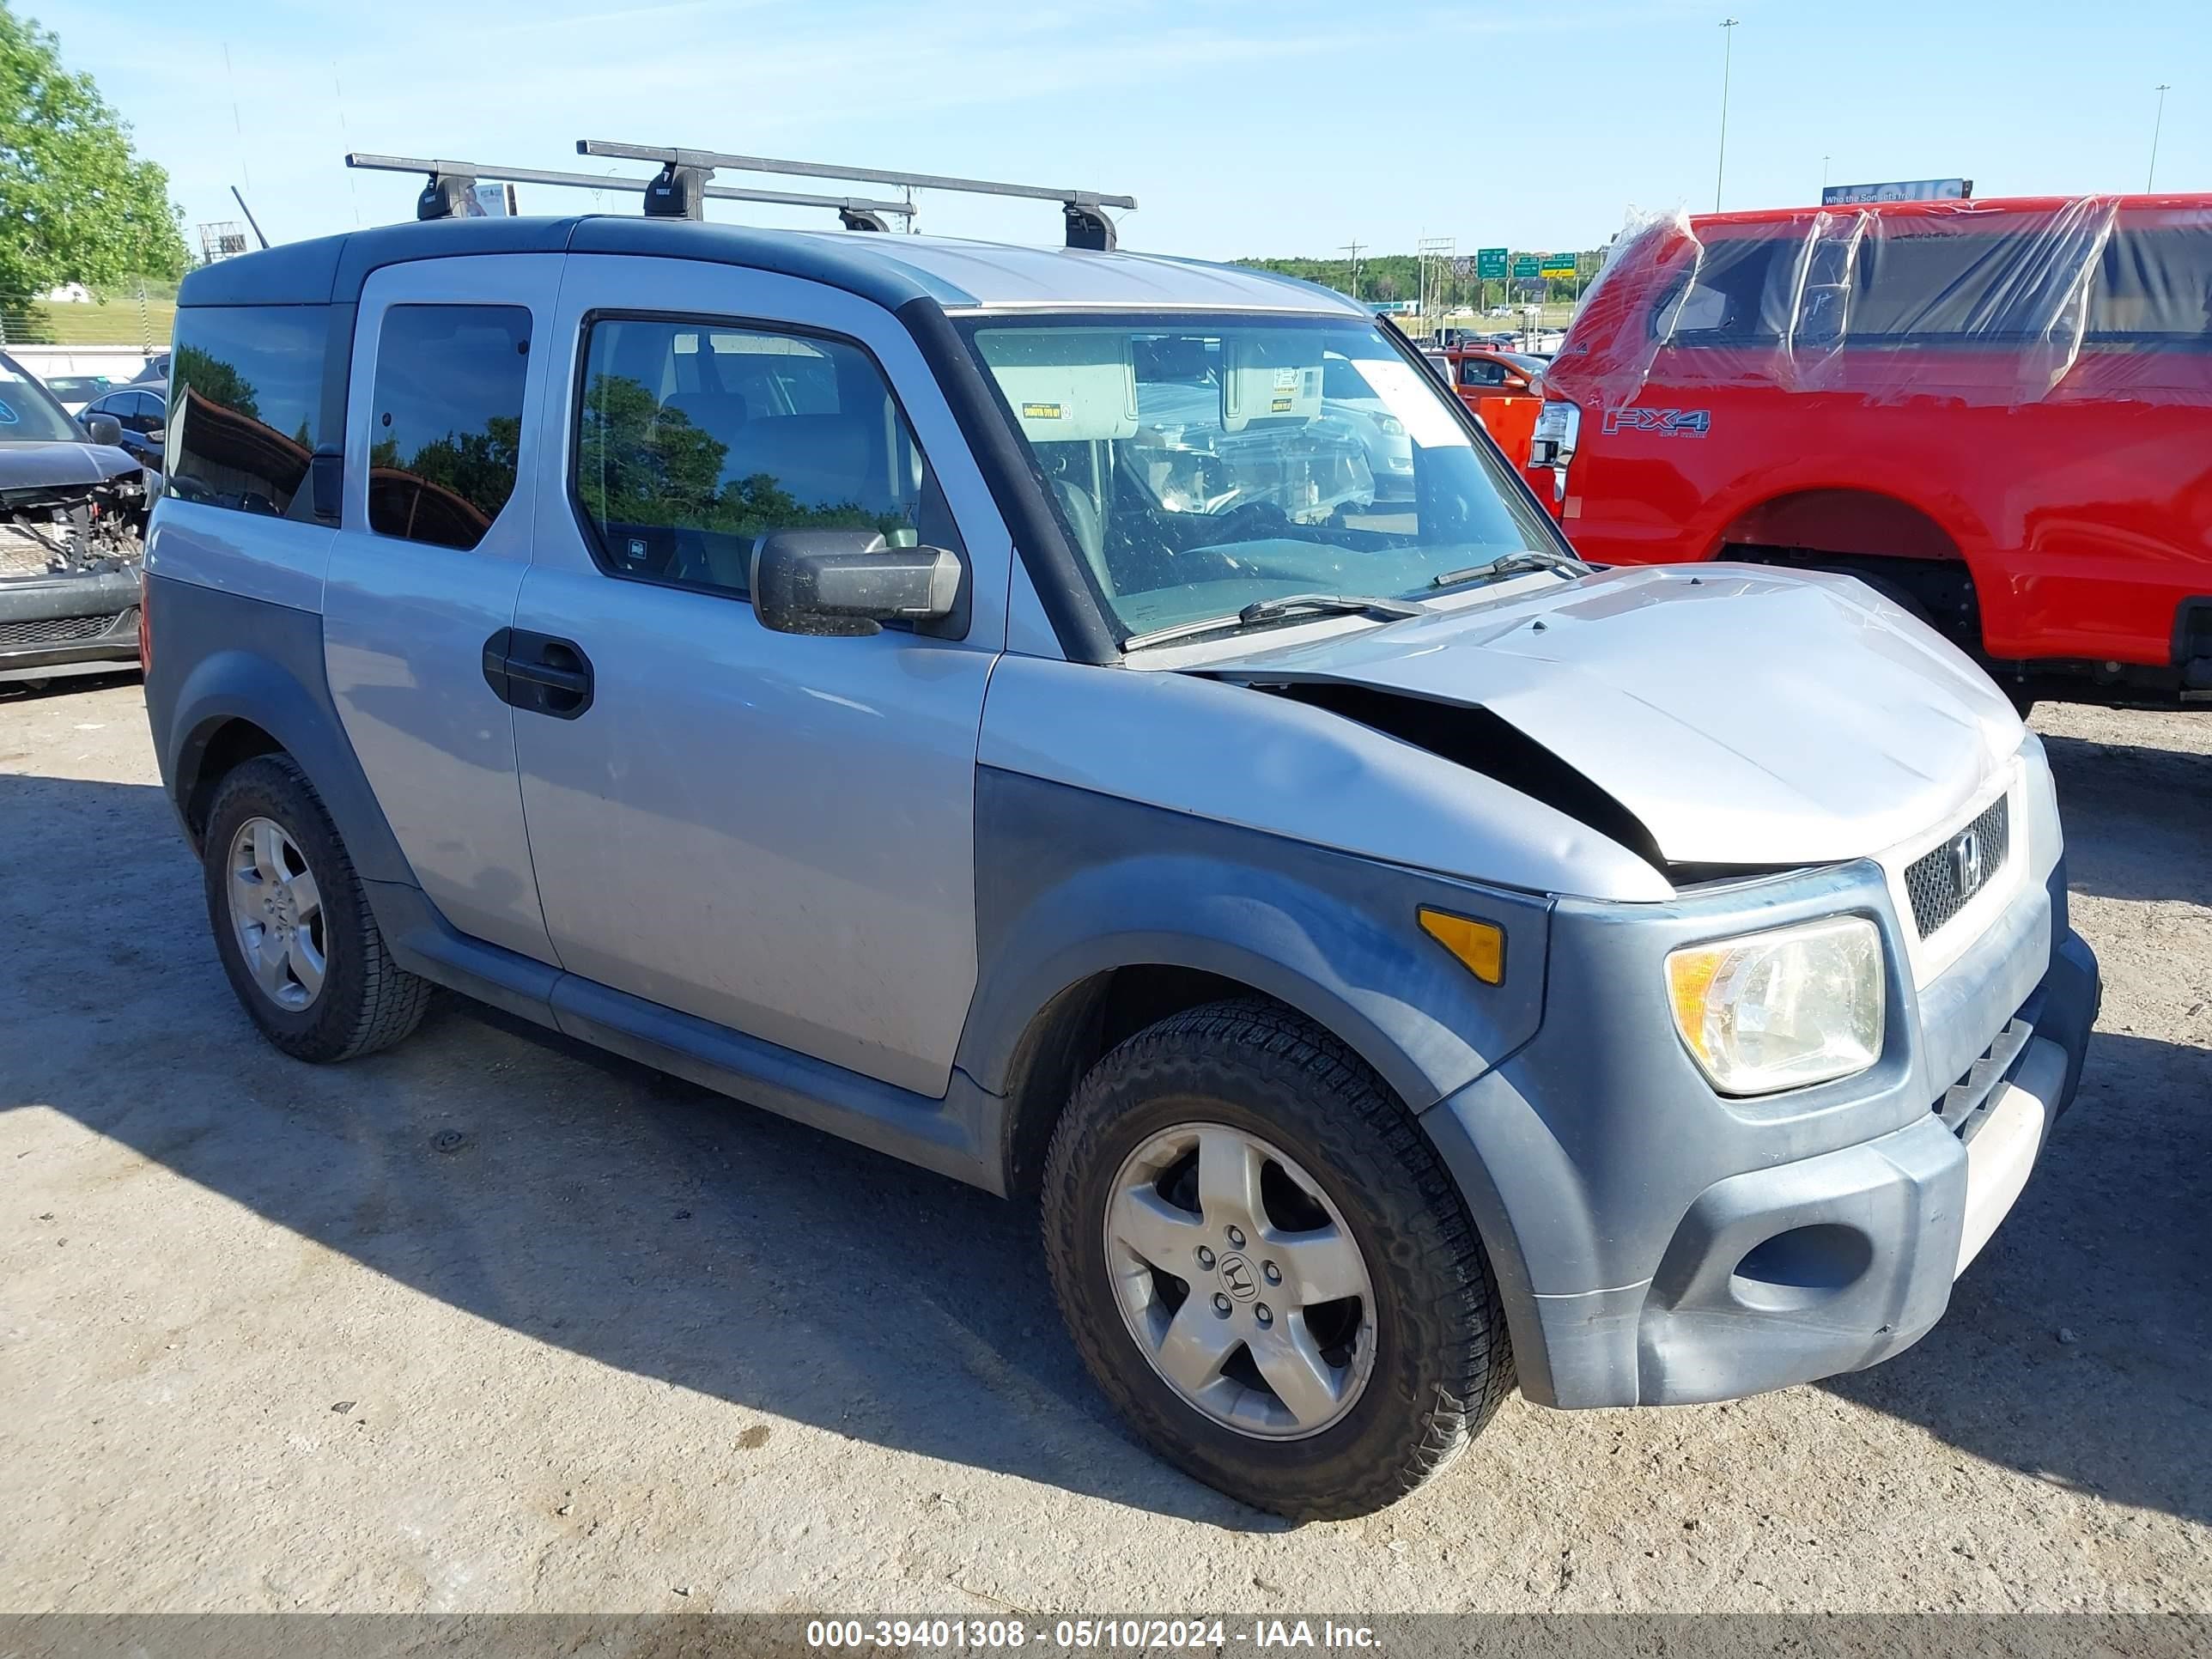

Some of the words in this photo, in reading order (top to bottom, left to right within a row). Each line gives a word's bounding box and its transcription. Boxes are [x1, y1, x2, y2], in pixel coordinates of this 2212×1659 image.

[1826, 195, 1844, 204] Who
[1845, 194, 1859, 204] the
[1861, 192, 1878, 202] Son
[1602, 408, 1711, 434] FX4
